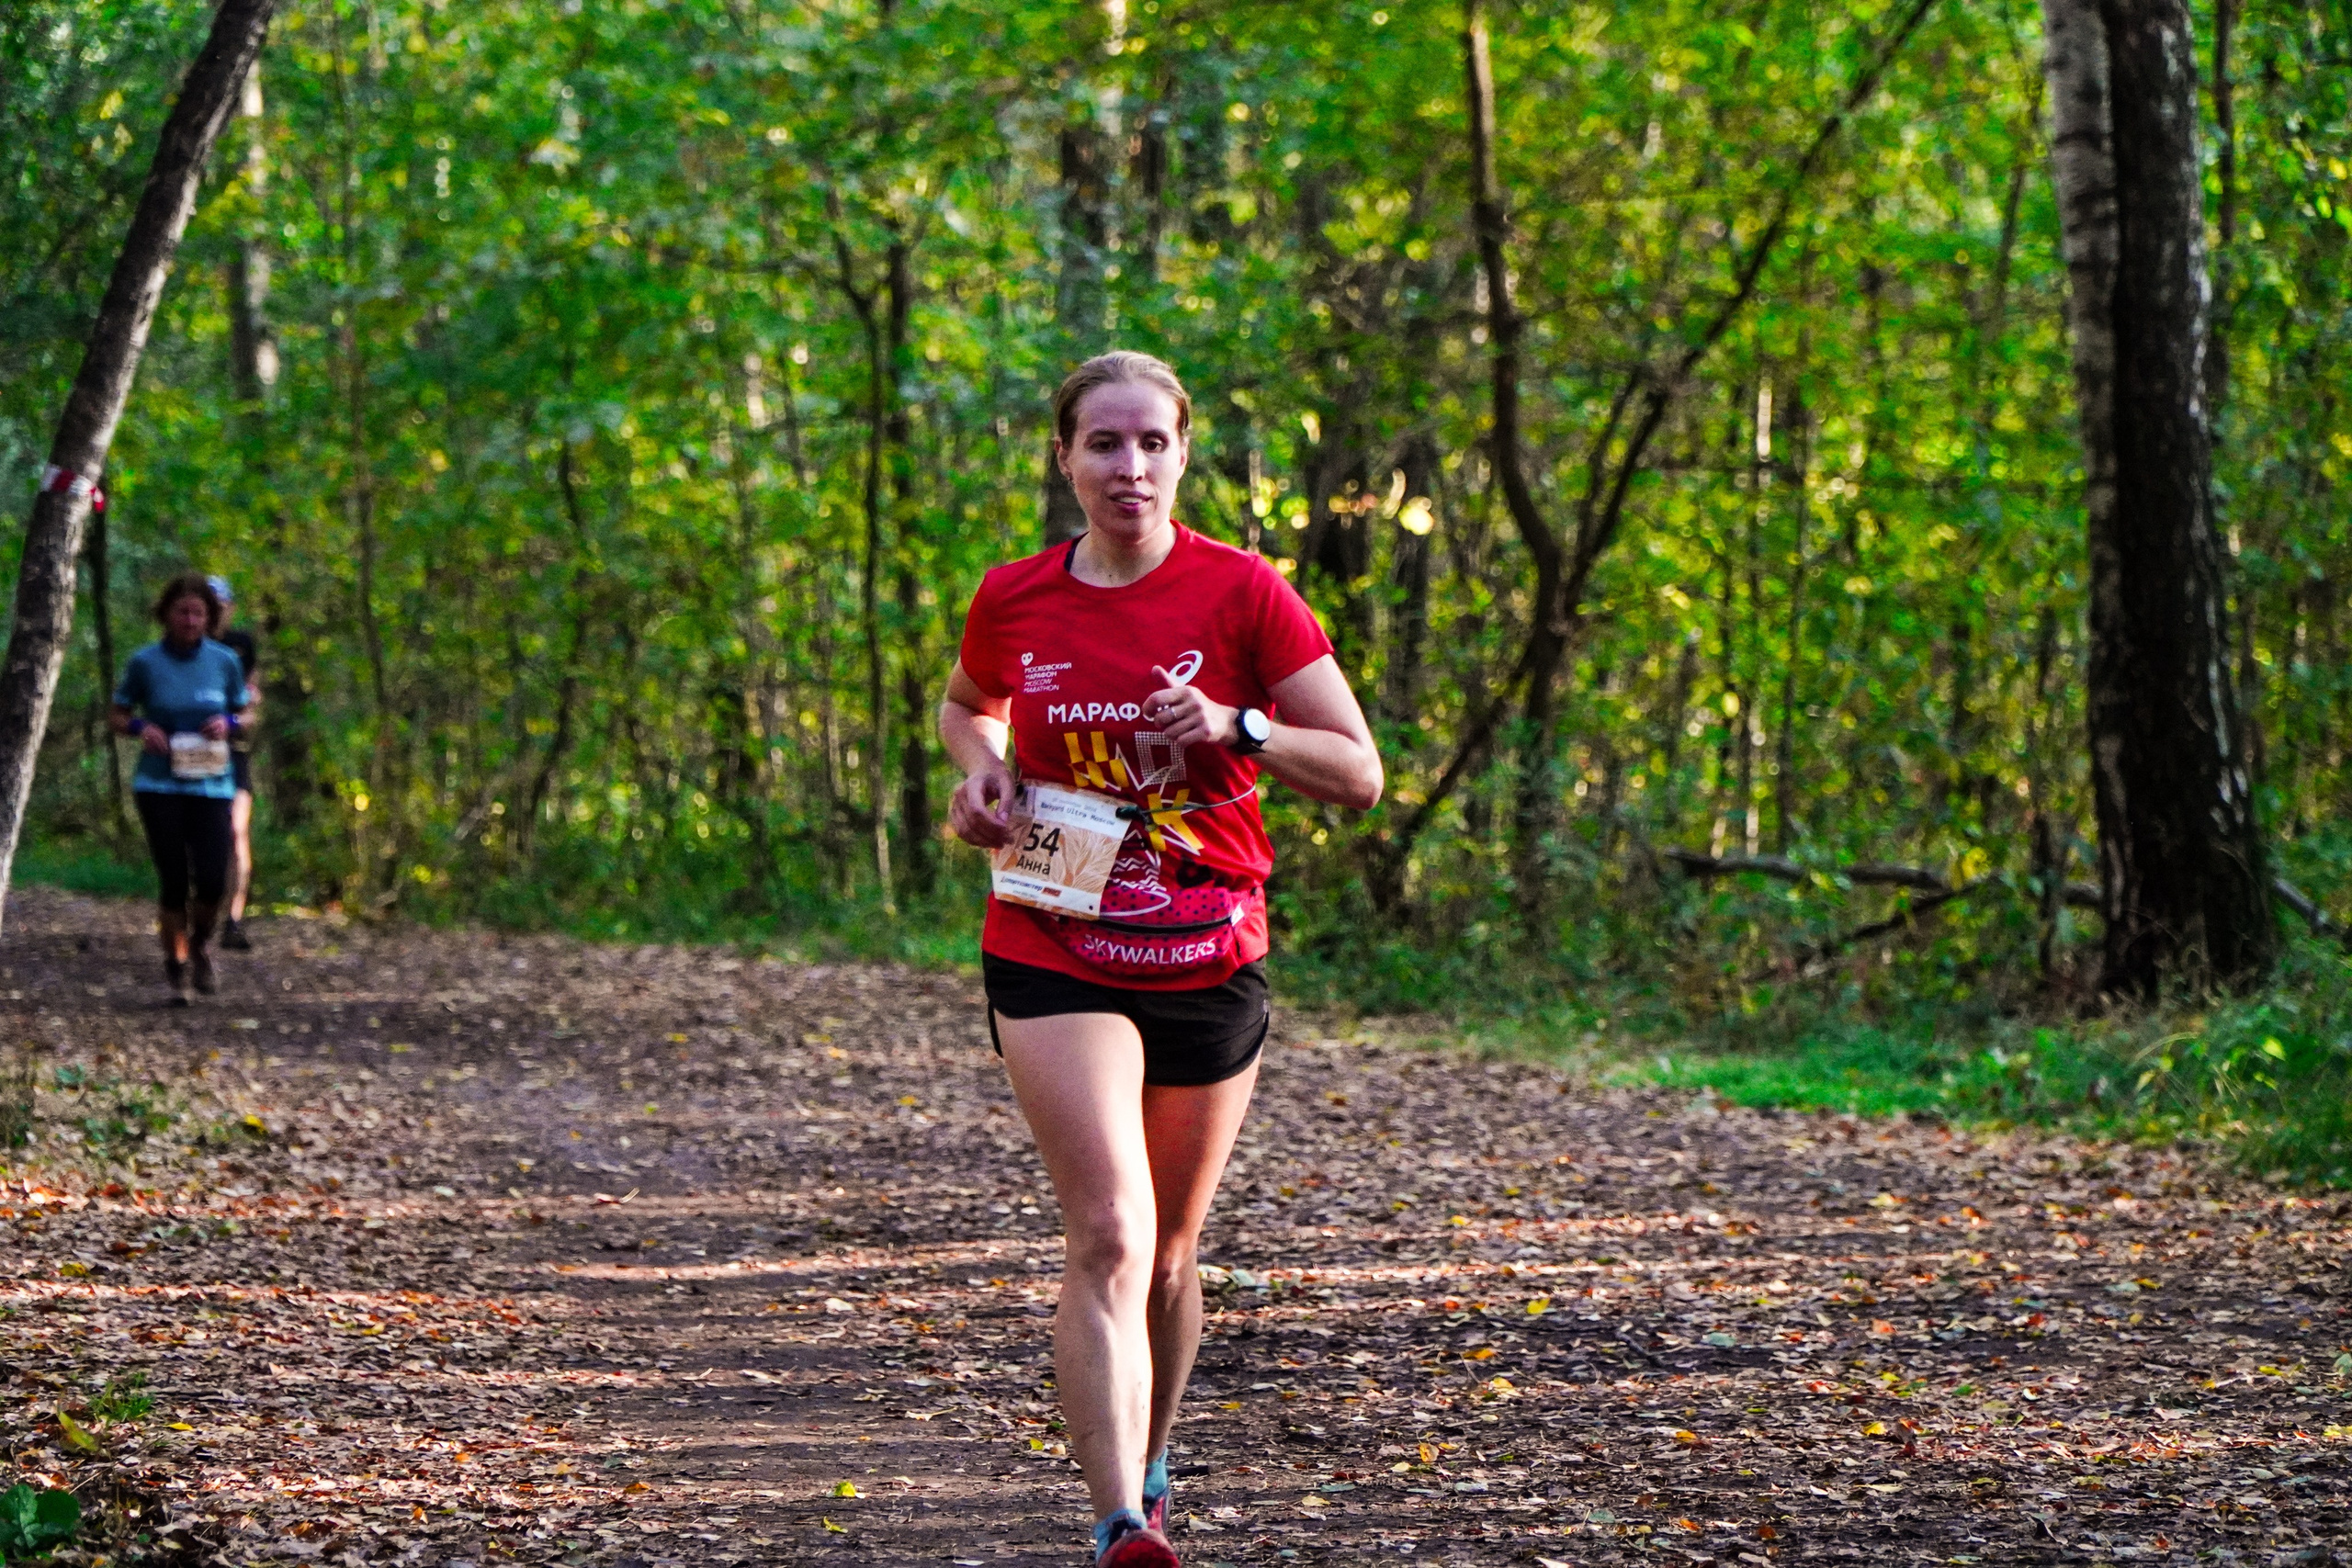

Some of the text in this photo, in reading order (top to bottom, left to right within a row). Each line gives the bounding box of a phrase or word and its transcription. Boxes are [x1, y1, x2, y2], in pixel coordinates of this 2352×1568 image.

[1024, 662, 1072, 673] МОСКОВСКИЙ
[1024, 671, 1057, 680] МАРАФОН
[1024, 678, 1053, 687] MOSCOW
[1023, 684, 1059, 694] MARATHON
[1023, 823, 1060, 857] 54
[1015, 855, 1051, 875] Анна
[1084, 933, 1217, 964] SKYWALKERS
